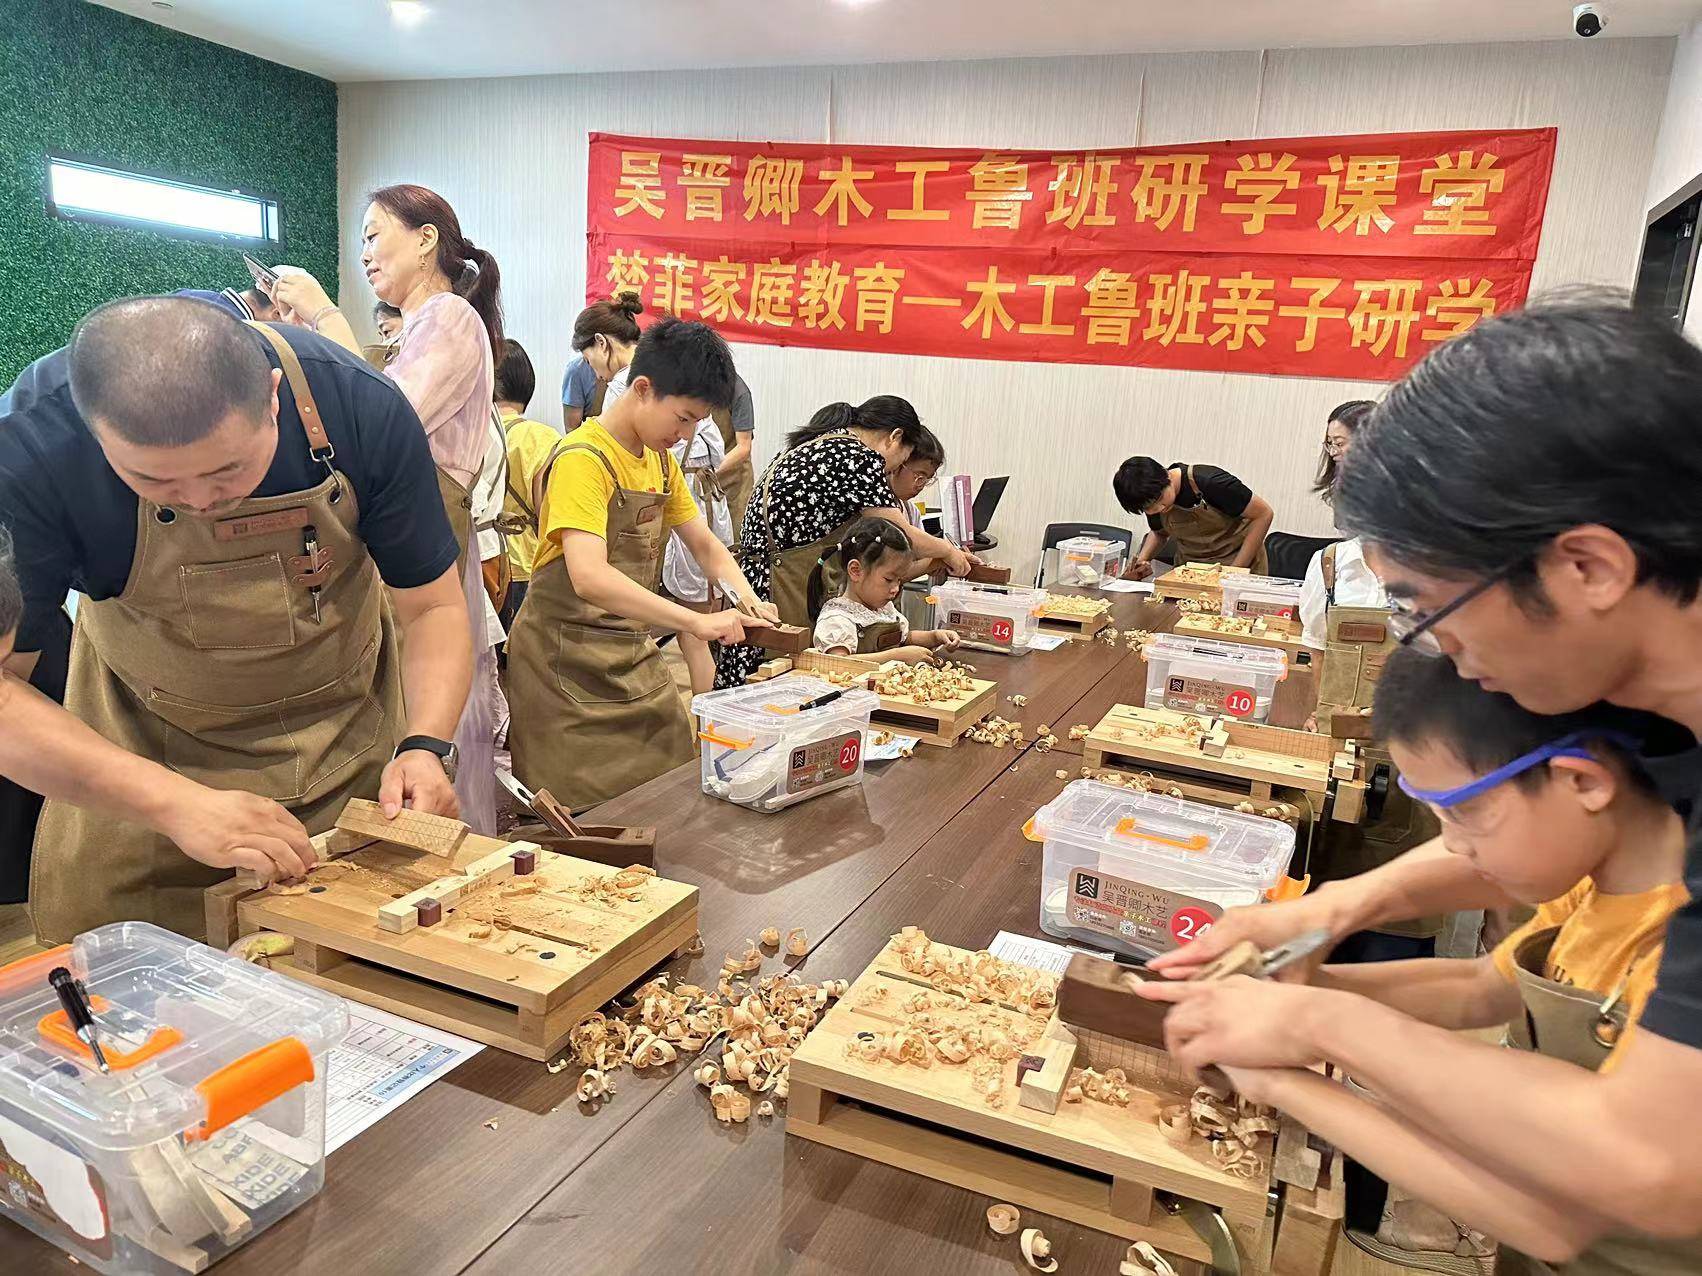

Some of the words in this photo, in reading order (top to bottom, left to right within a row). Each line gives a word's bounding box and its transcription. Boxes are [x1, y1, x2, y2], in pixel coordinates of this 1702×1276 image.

[613, 150, 1505, 236] 吴晋卿木工鲁班研学课堂
[993, 625, 1009, 637] 14
[1229, 695, 1251, 711] 10
[842, 745, 857, 764] 20
[1102, 891, 1168, 919] 吴晋卿木艺
